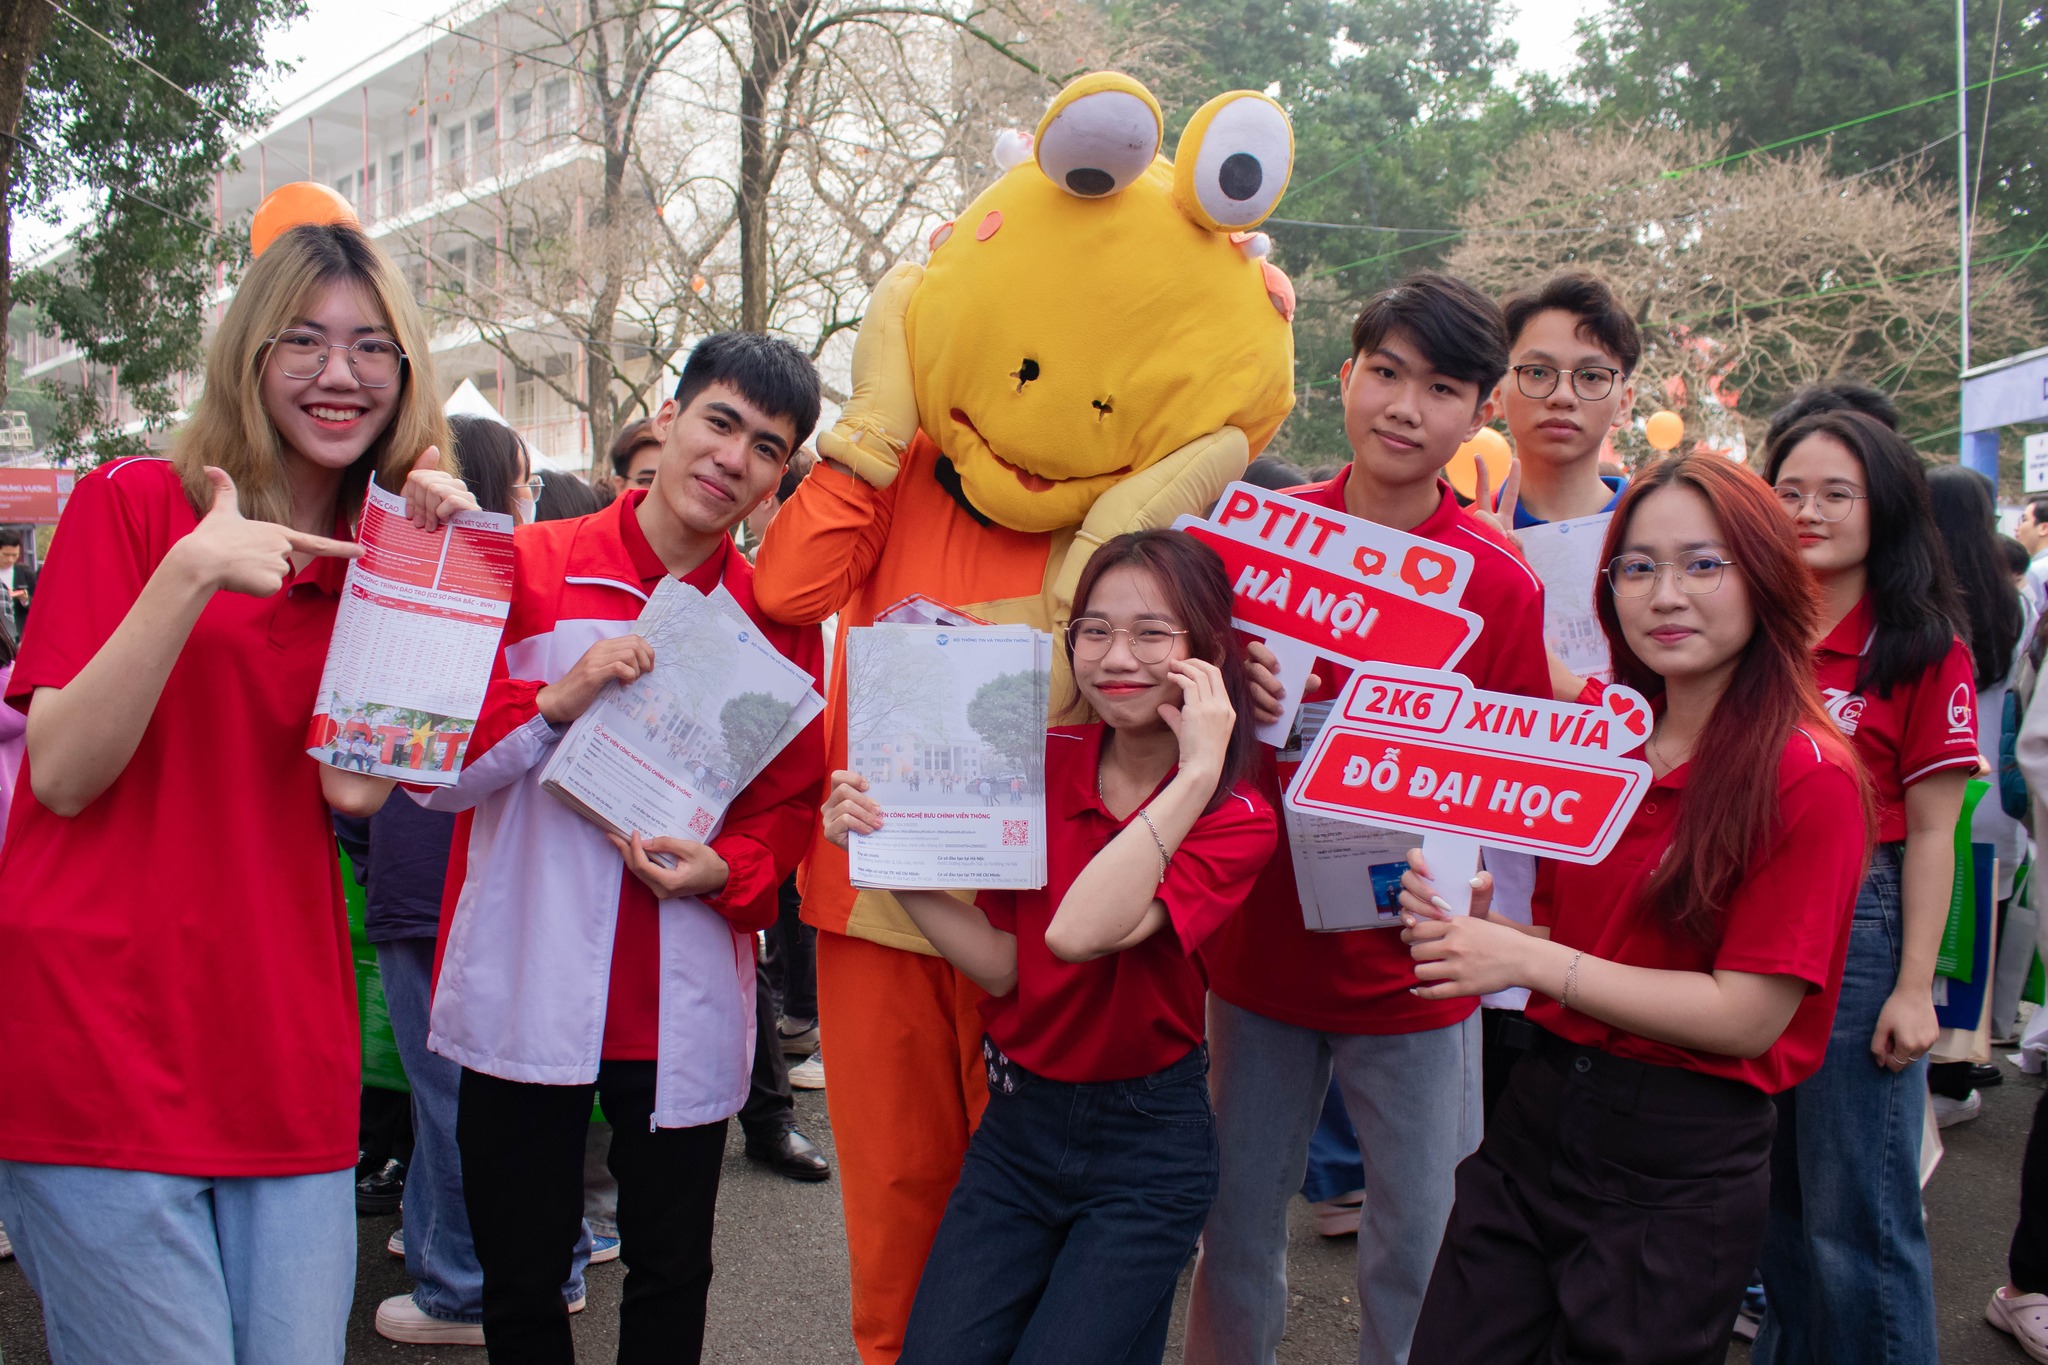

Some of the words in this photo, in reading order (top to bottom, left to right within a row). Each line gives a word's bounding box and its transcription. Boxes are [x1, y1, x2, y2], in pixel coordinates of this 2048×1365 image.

[1217, 489, 1347, 558] PTIT
[1233, 564, 1292, 611] HÀ
[1296, 586, 1380, 639] NỘI
[1365, 686, 1435, 720] 2K6
[1464, 701, 1538, 738] XIN
[1550, 709, 1610, 750] VÍA
[610, 738, 619, 748] VIỆN
[619, 745, 631, 757] CÔNG
[631, 754, 643, 766] NGHỆ
[652, 769, 665, 781] CHÍNH
[676, 785, 692, 799] THÔNG
[1342, 747, 1401, 793] ĐỖ
[1408, 766, 1482, 813] ĐẠI
[1488, 779, 1582, 828] HỌC
[890, 811, 905, 819] CÔNG
[906, 811, 922, 819] NGHỆ
[924, 811, 935, 819] BƯU
[937, 811, 954, 819] CHÍNH
[955, 811, 969, 819] VIỄN
